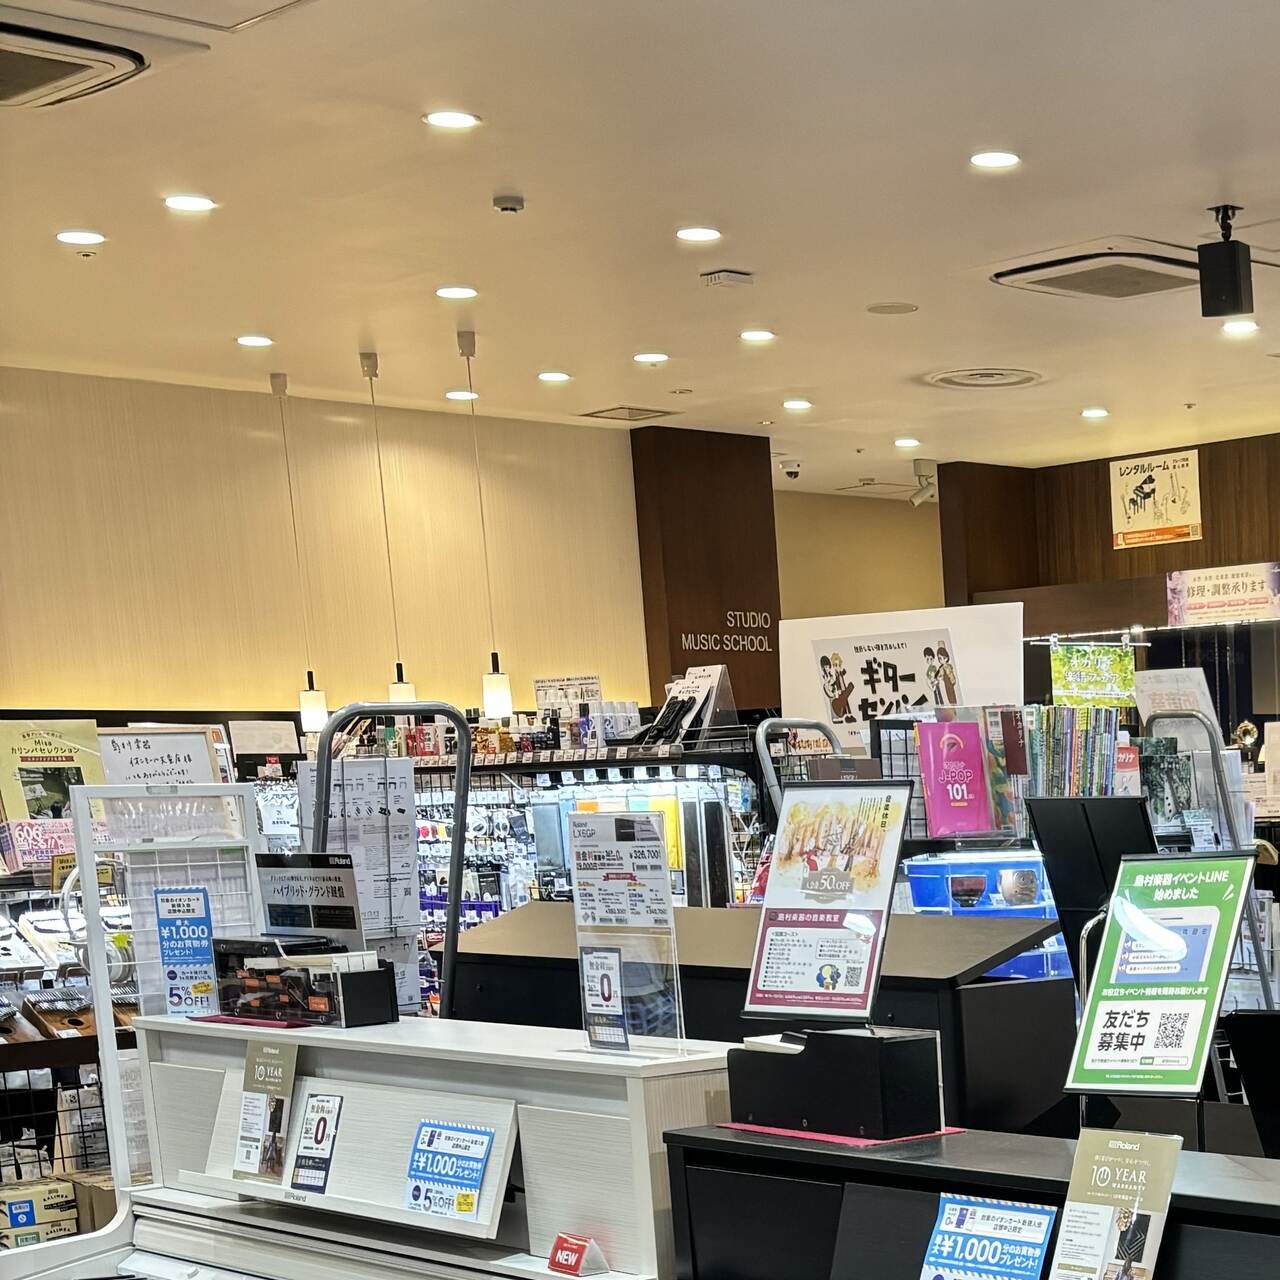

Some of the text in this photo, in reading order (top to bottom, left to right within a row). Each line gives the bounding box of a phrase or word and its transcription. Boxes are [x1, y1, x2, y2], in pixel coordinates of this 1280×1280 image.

[1120, 461, 1170, 477] レンタルルーム
[1187, 580, 1266, 598] 修理・調整承ります
[727, 611, 770, 628] STUDIO
[682, 633, 773, 651] MUSIC SCHOOL
[861, 657, 916, 694] ギター
[939, 769, 974, 784] J-POP
[1134, 870, 1229, 887] 島村楽器イベントLINE
[1153, 888, 1199, 900] 始めました
[161, 925, 208, 939] ¥1,000
[600, 973, 612, 1003] 0
[1103, 1009, 1151, 1029] 友だち
[1098, 1032, 1146, 1052] 募集中
[267, 1066, 283, 1078] YEAR
[314, 1116, 327, 1145] 0
[1117, 1141, 1140, 1151] Roland
[418, 1152, 457, 1176] ¥1,000
[1091, 1165, 1147, 1187] 10 YEAR
[941, 1234, 1003, 1263] ¥1,000
[555, 1249, 579, 1266] NEW
[1000, 1254, 1038, 1270] プレゼント!
